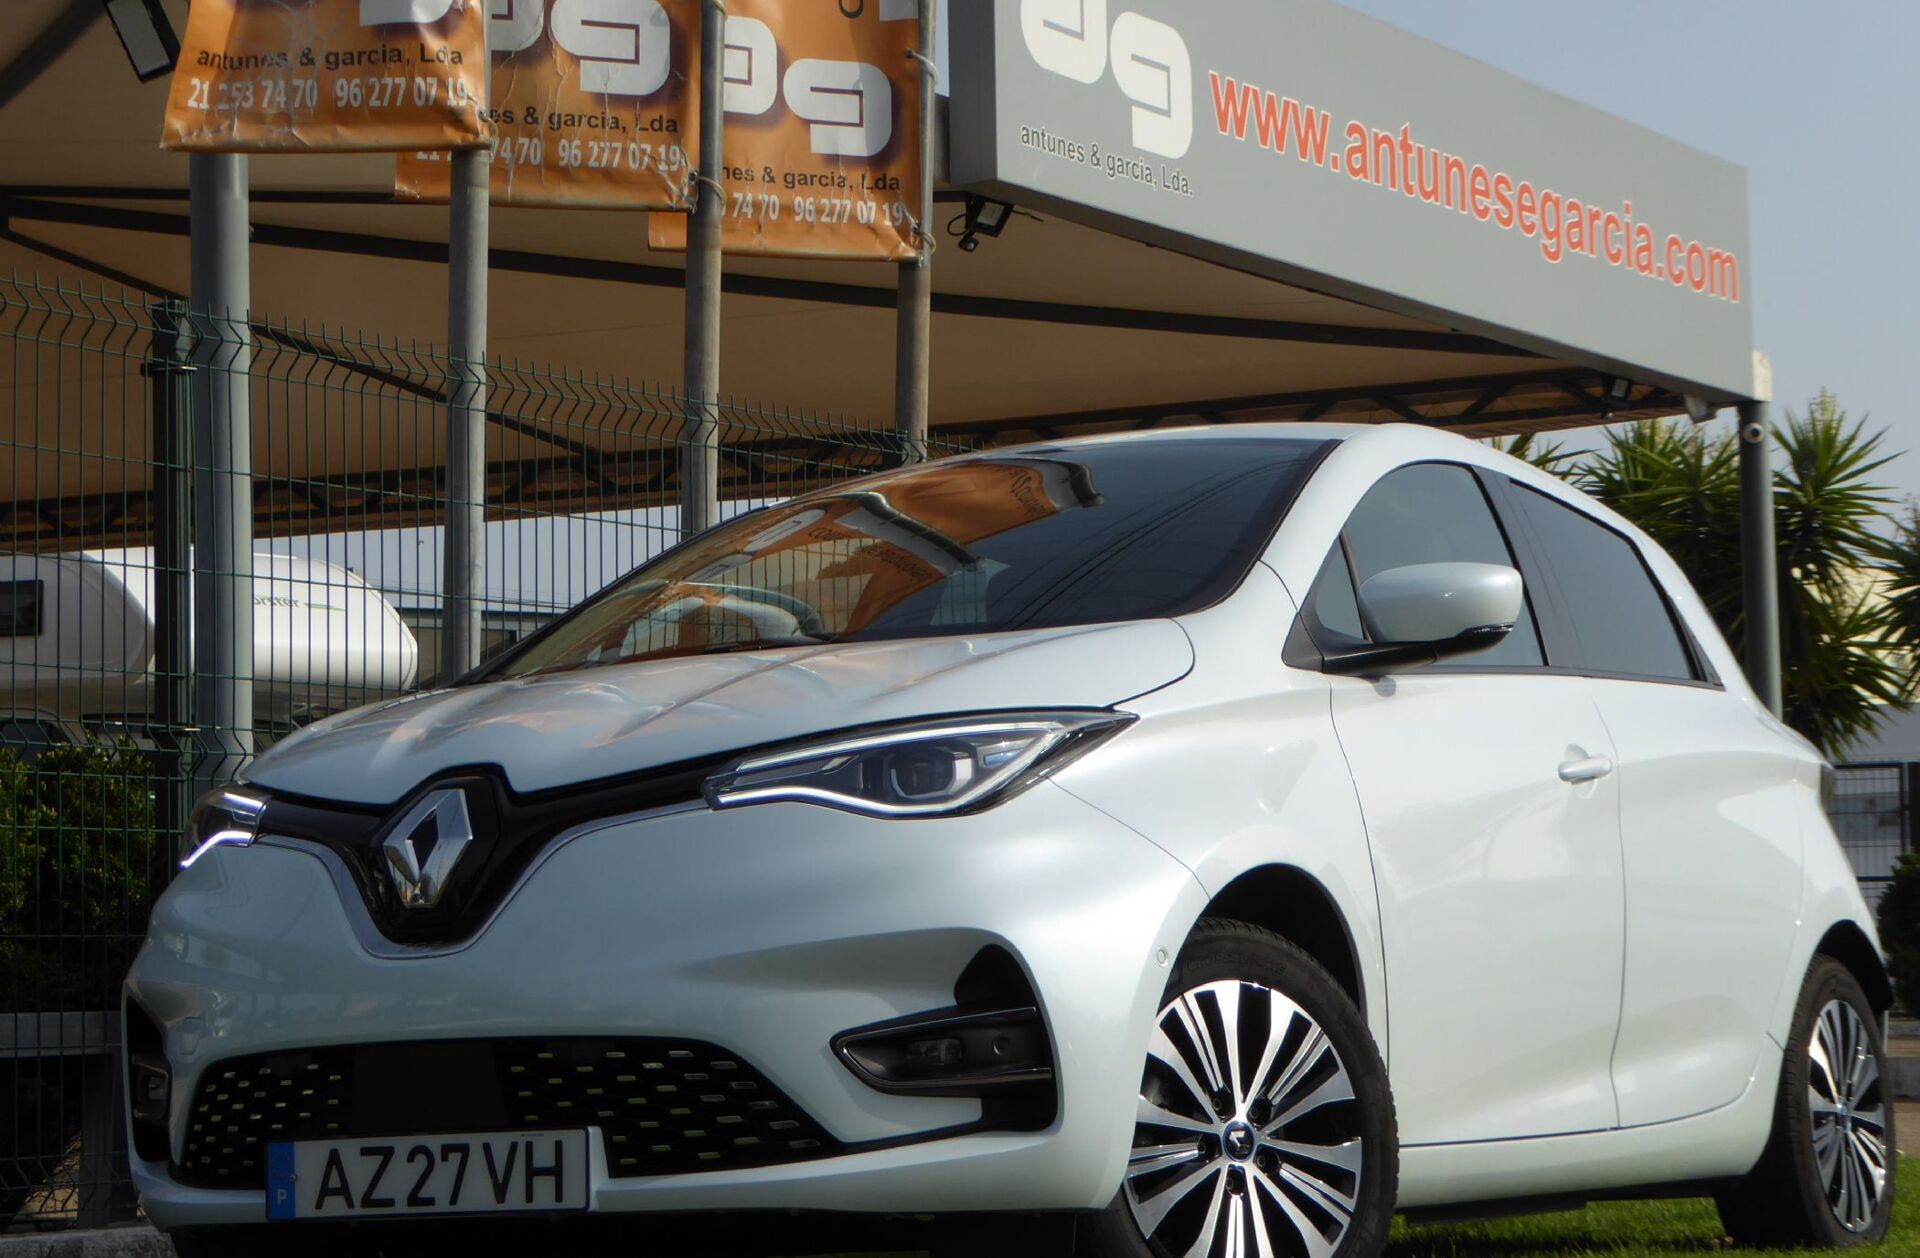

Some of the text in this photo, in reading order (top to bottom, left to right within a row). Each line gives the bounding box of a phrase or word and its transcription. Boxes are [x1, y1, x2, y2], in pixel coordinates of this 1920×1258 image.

[197, 48, 288, 70] antunes
[299, 47, 316, 66] &
[325, 44, 411, 70] garcia,
[187, 77, 469, 110] 21 253 74 70 96 277 07 19
[523, 106, 540, 125] &
[548, 112, 627, 133] garcia,
[637, 113, 678, 133] Lda
[517, 137, 542, 165] 70
[558, 140, 582, 168] 96
[588, 141, 622, 169] 277
[628, 143, 651, 170] 07
[657, 143, 684, 171] 19
[1021, 124, 1194, 196] antunes & garcia, Lda.
[762, 166, 777, 184] &
[783, 169, 853, 192] garcia,
[861, 173, 900, 191] Lda
[1208, 69, 1740, 303] www.antunesegarcia.com
[732, 192, 903, 225] 74 70 96 277 07 19
[276, 1188, 288, 1205] P
